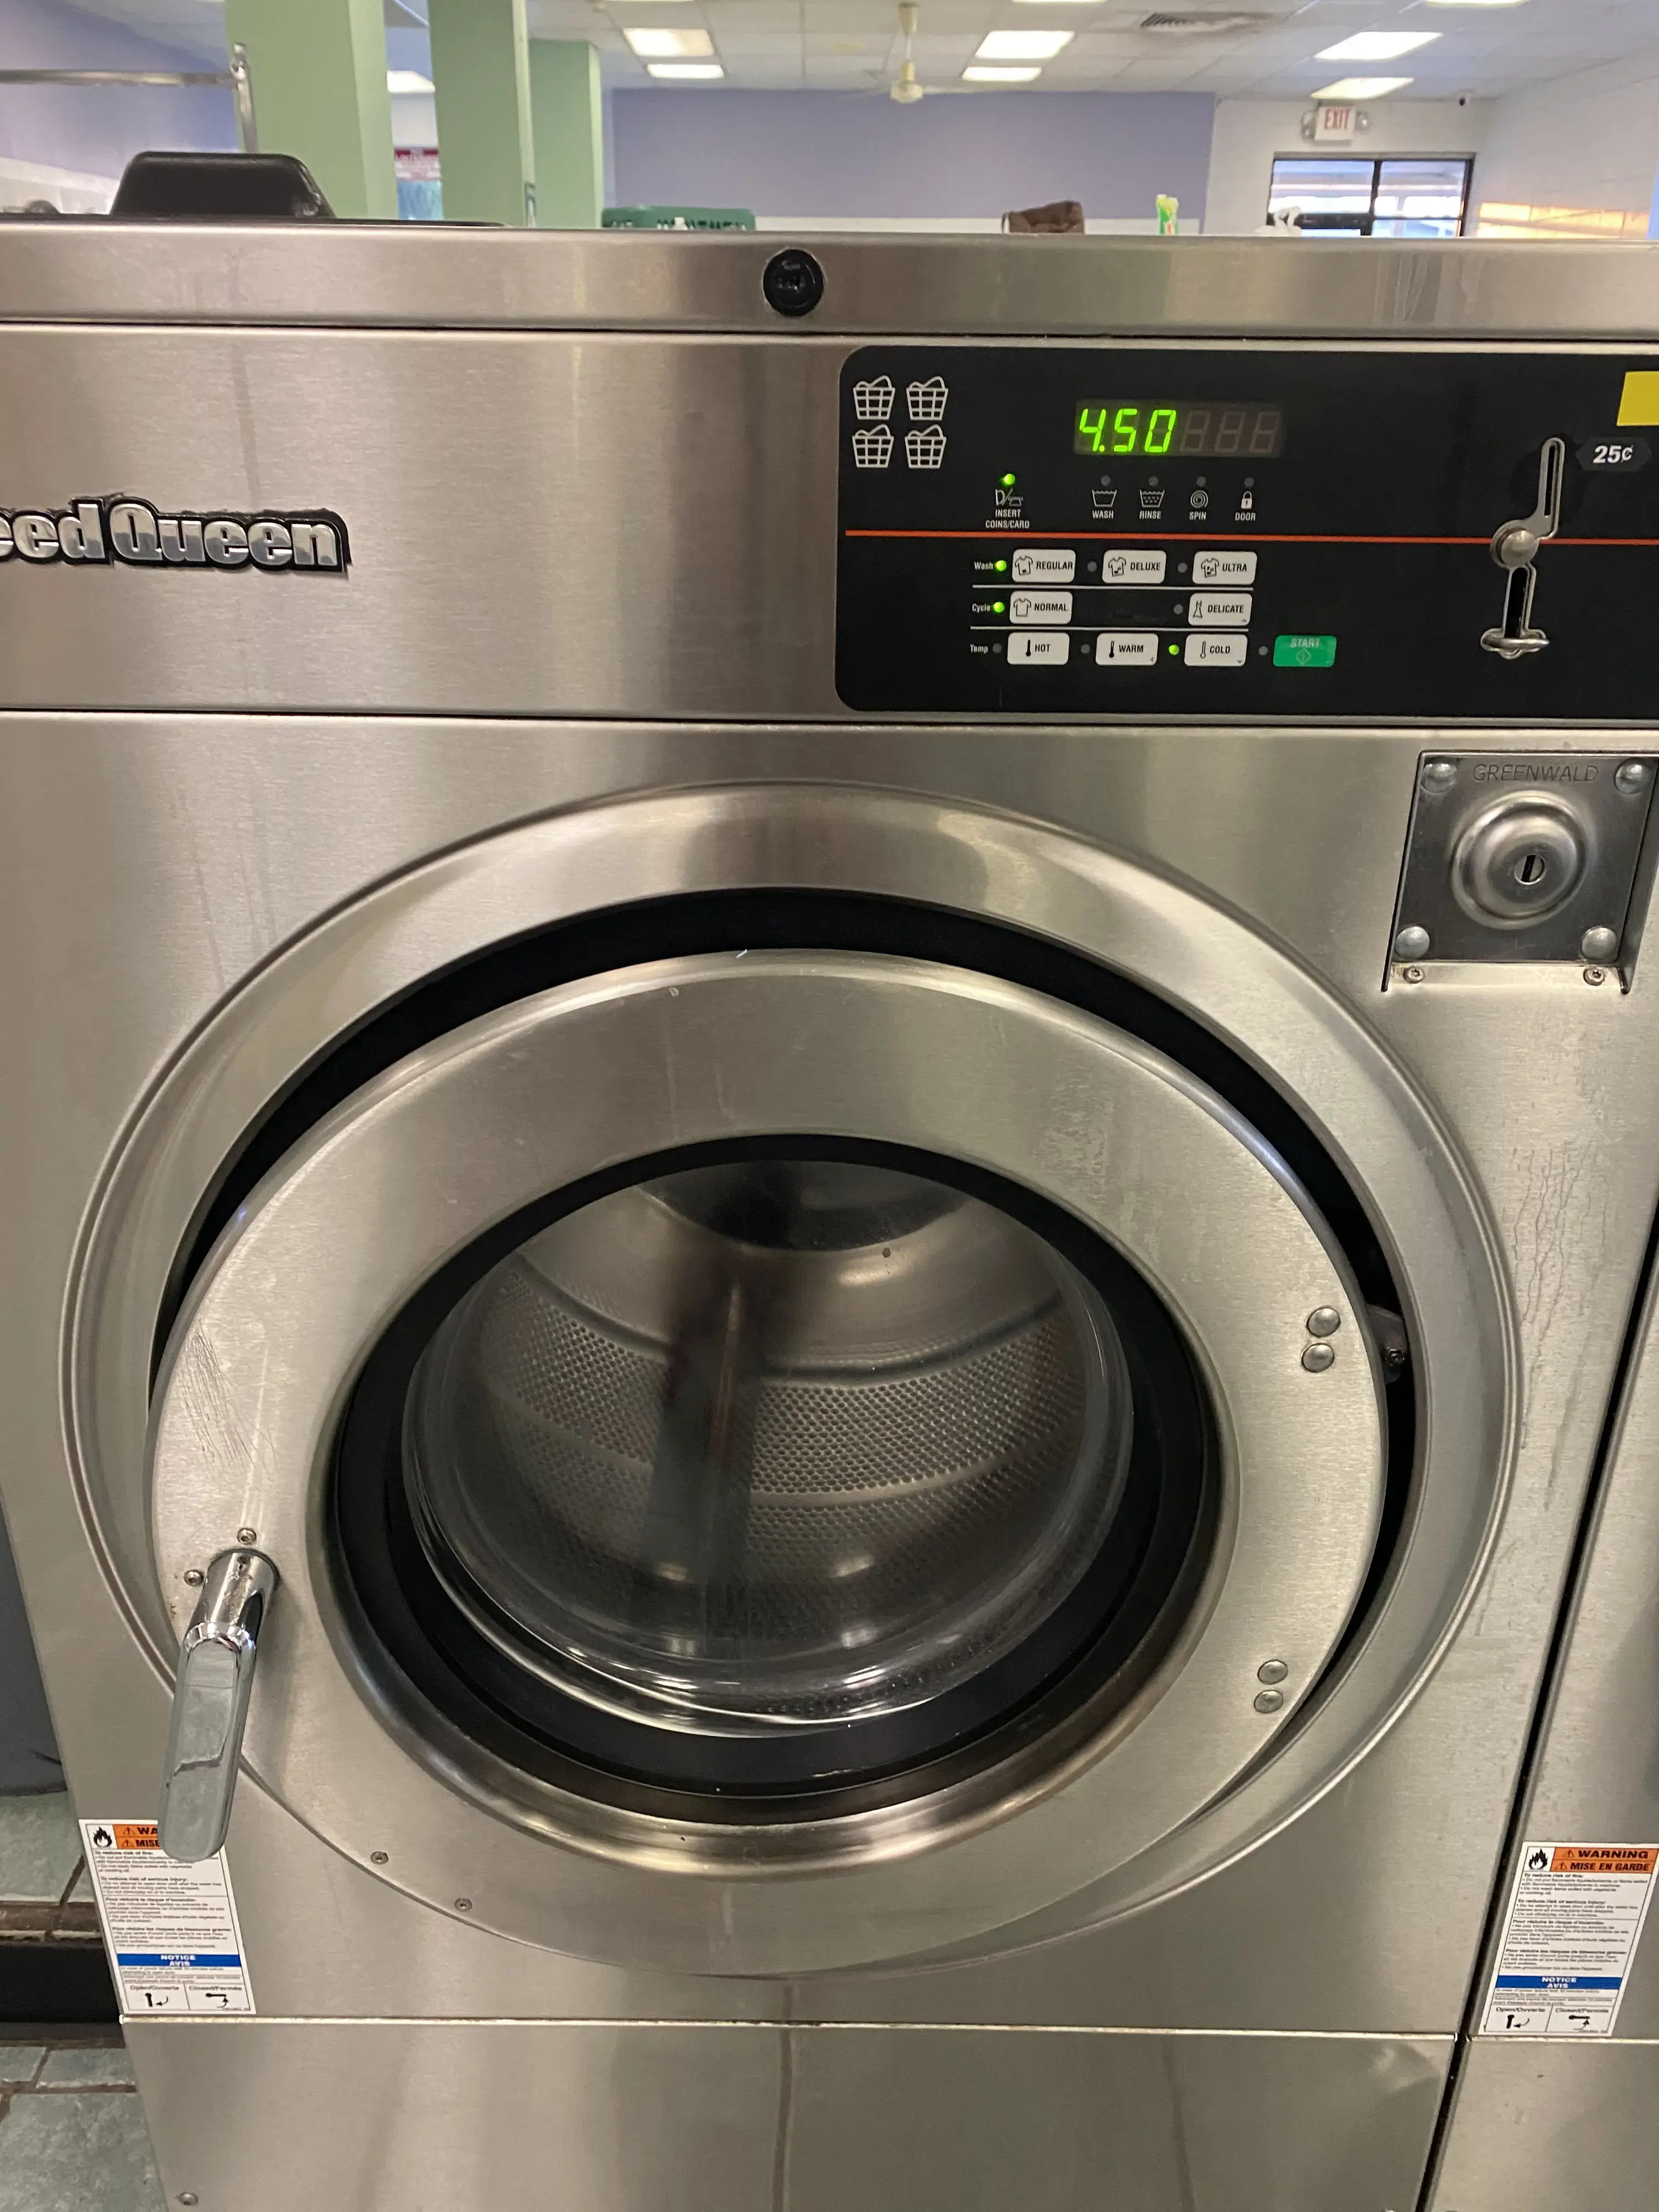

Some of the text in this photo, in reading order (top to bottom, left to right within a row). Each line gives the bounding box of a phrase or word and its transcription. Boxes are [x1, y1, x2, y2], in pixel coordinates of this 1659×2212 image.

[1324, 108, 1350, 129] EXIT
[1079, 408, 1177, 453] 4.50
[995, 509, 1022, 518] INSERT
[1092, 510, 1114, 520] WASH
[1139, 510, 1162, 520] RINSE
[1189, 511, 1207, 521] SPIN
[1234, 511, 1256, 521] DOOR
[985, 519, 1030, 529] COINS/CARD
[110, 503, 339, 567] Queen
[974, 561, 994, 570] Wash
[1036, 561, 1074, 570] REGULAR
[1130, 562, 1161, 571] DELUXE
[1222, 563, 1248, 572] ULTRA
[972, 603, 991, 613] Cycle
[1034, 603, 1068, 612] NORMAL
[1207, 605, 1244, 613] DELICATE
[1290, 636, 1321, 648] START
[970, 644, 988, 654] Temp
[1035, 644, 1051, 652] HOT
[1118, 644, 1144, 653] WARM
[1209, 645, 1231, 654] COLD
[1472, 764, 1599, 783] GREENWALD
[1578, 1849, 1649, 1859] WARNING
[1570, 1862, 1650, 1871] MISE EN GARDE
